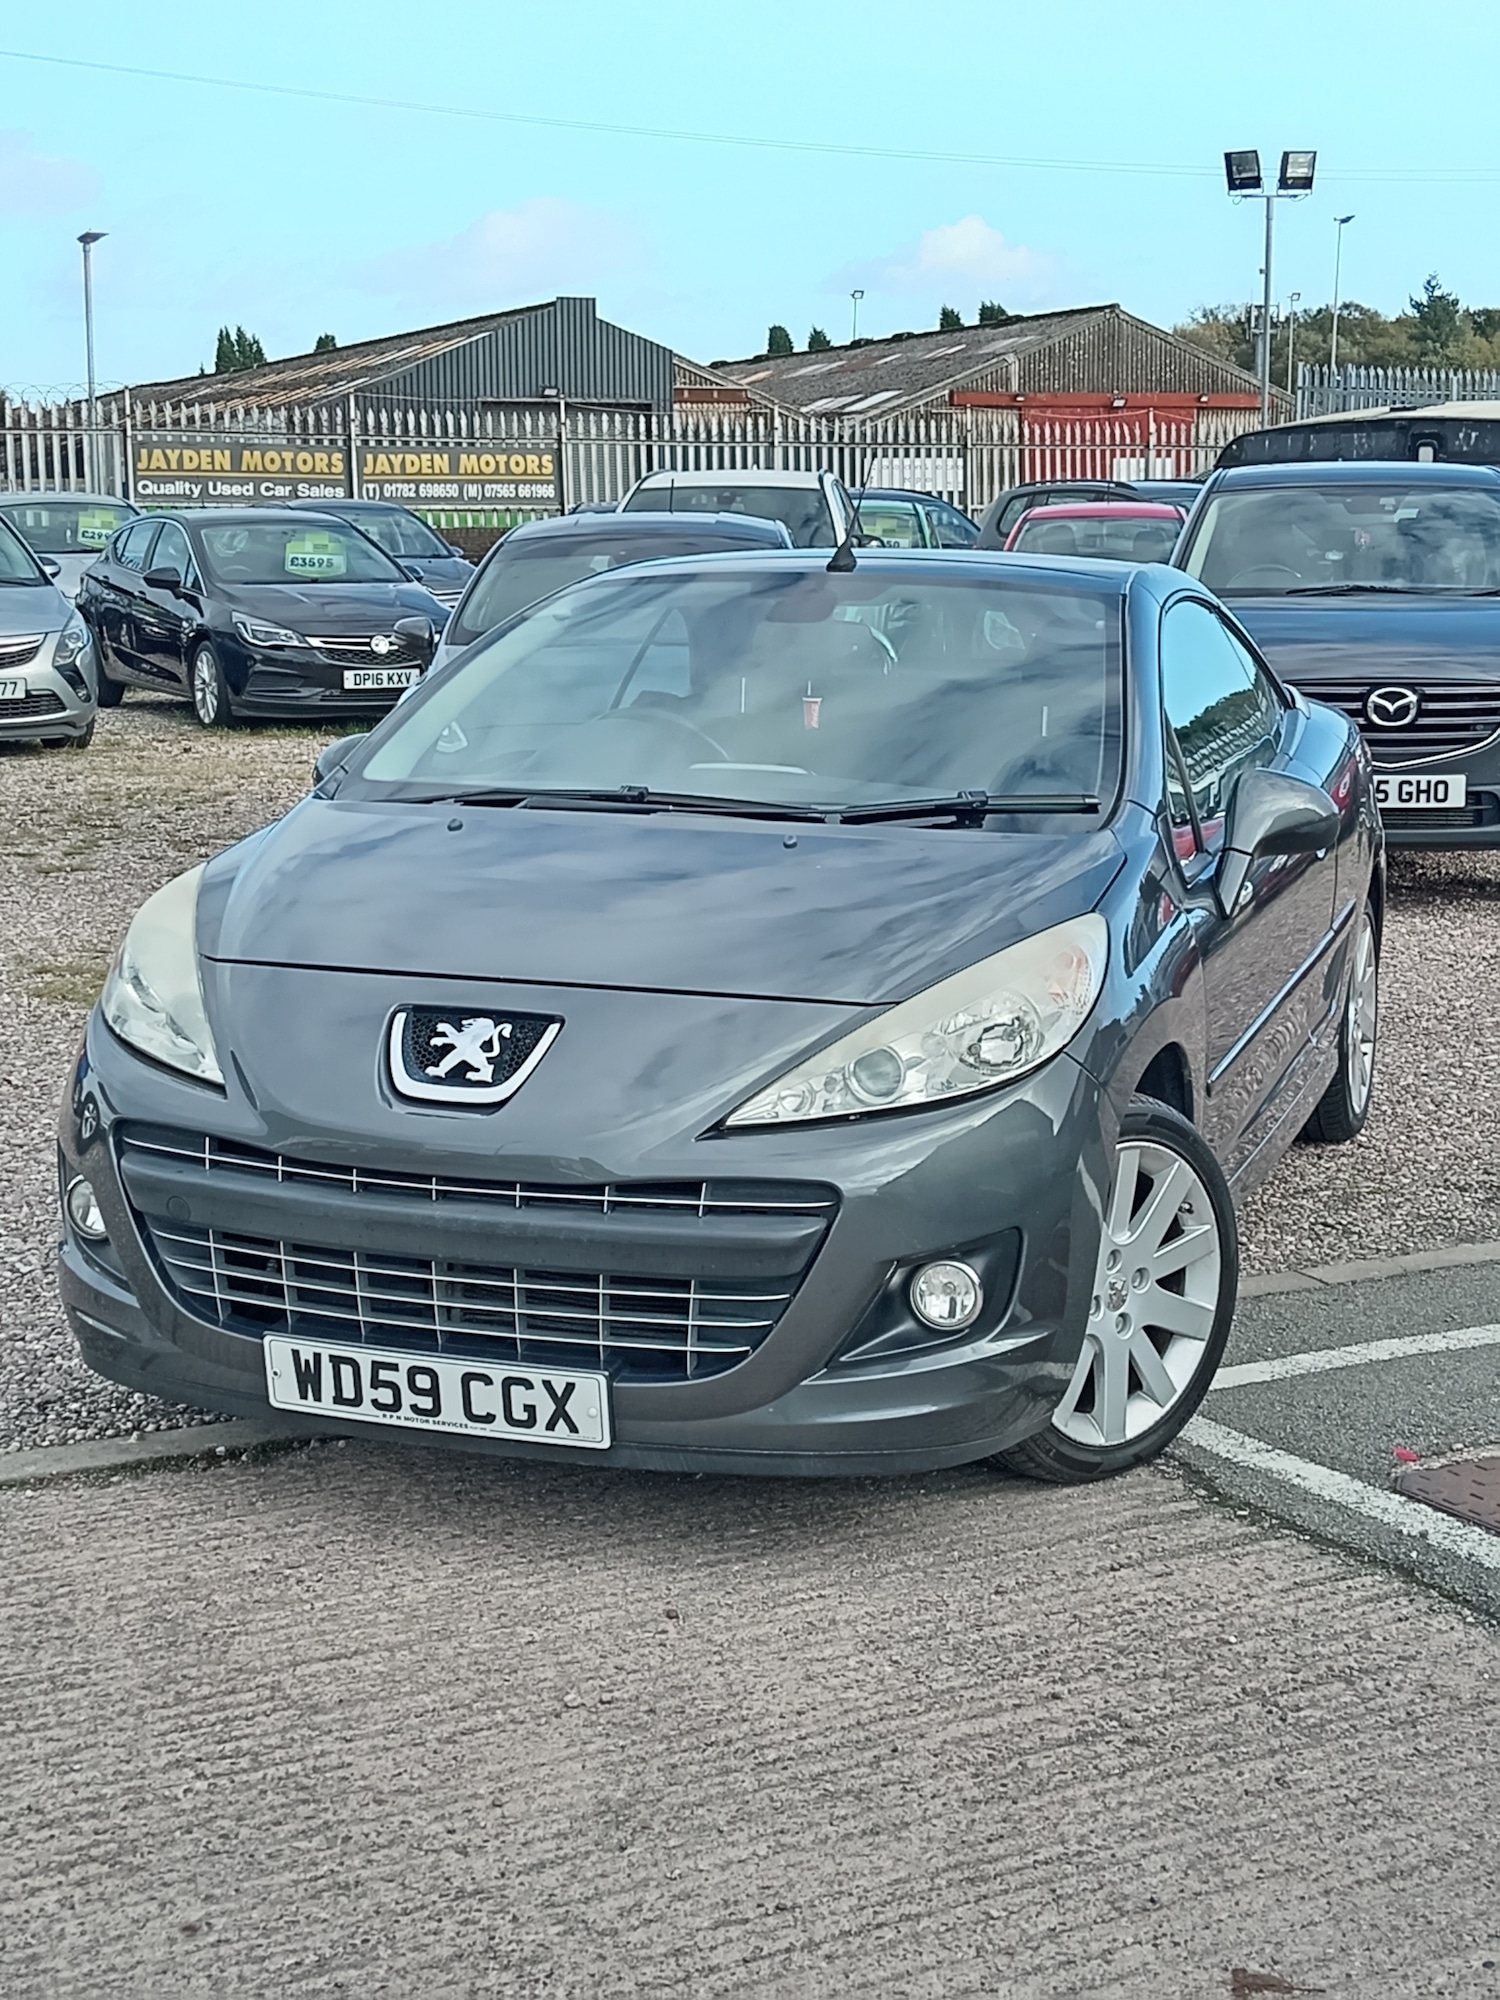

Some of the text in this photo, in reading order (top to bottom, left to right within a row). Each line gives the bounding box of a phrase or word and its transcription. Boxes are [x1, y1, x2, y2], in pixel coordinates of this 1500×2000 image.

[137, 448, 344, 474] JAYDEN MOTORS
[363, 453, 554, 475] JAYDEN MOTORS
[137, 480, 345, 498] Quality Used Car Sales
[362, 483, 555, 501] (T) 01782 698650 (M) 07565 661966
[289, 556, 334, 568] £3595
[353, 672, 411, 686] DP16 KXV
[1398, 779, 1449, 803] GHO
[291, 1348, 579, 1434] WD59 CGX
[403, 1416, 430, 1424] MOTOR
[432, 1420, 468, 1429] SERVICES
